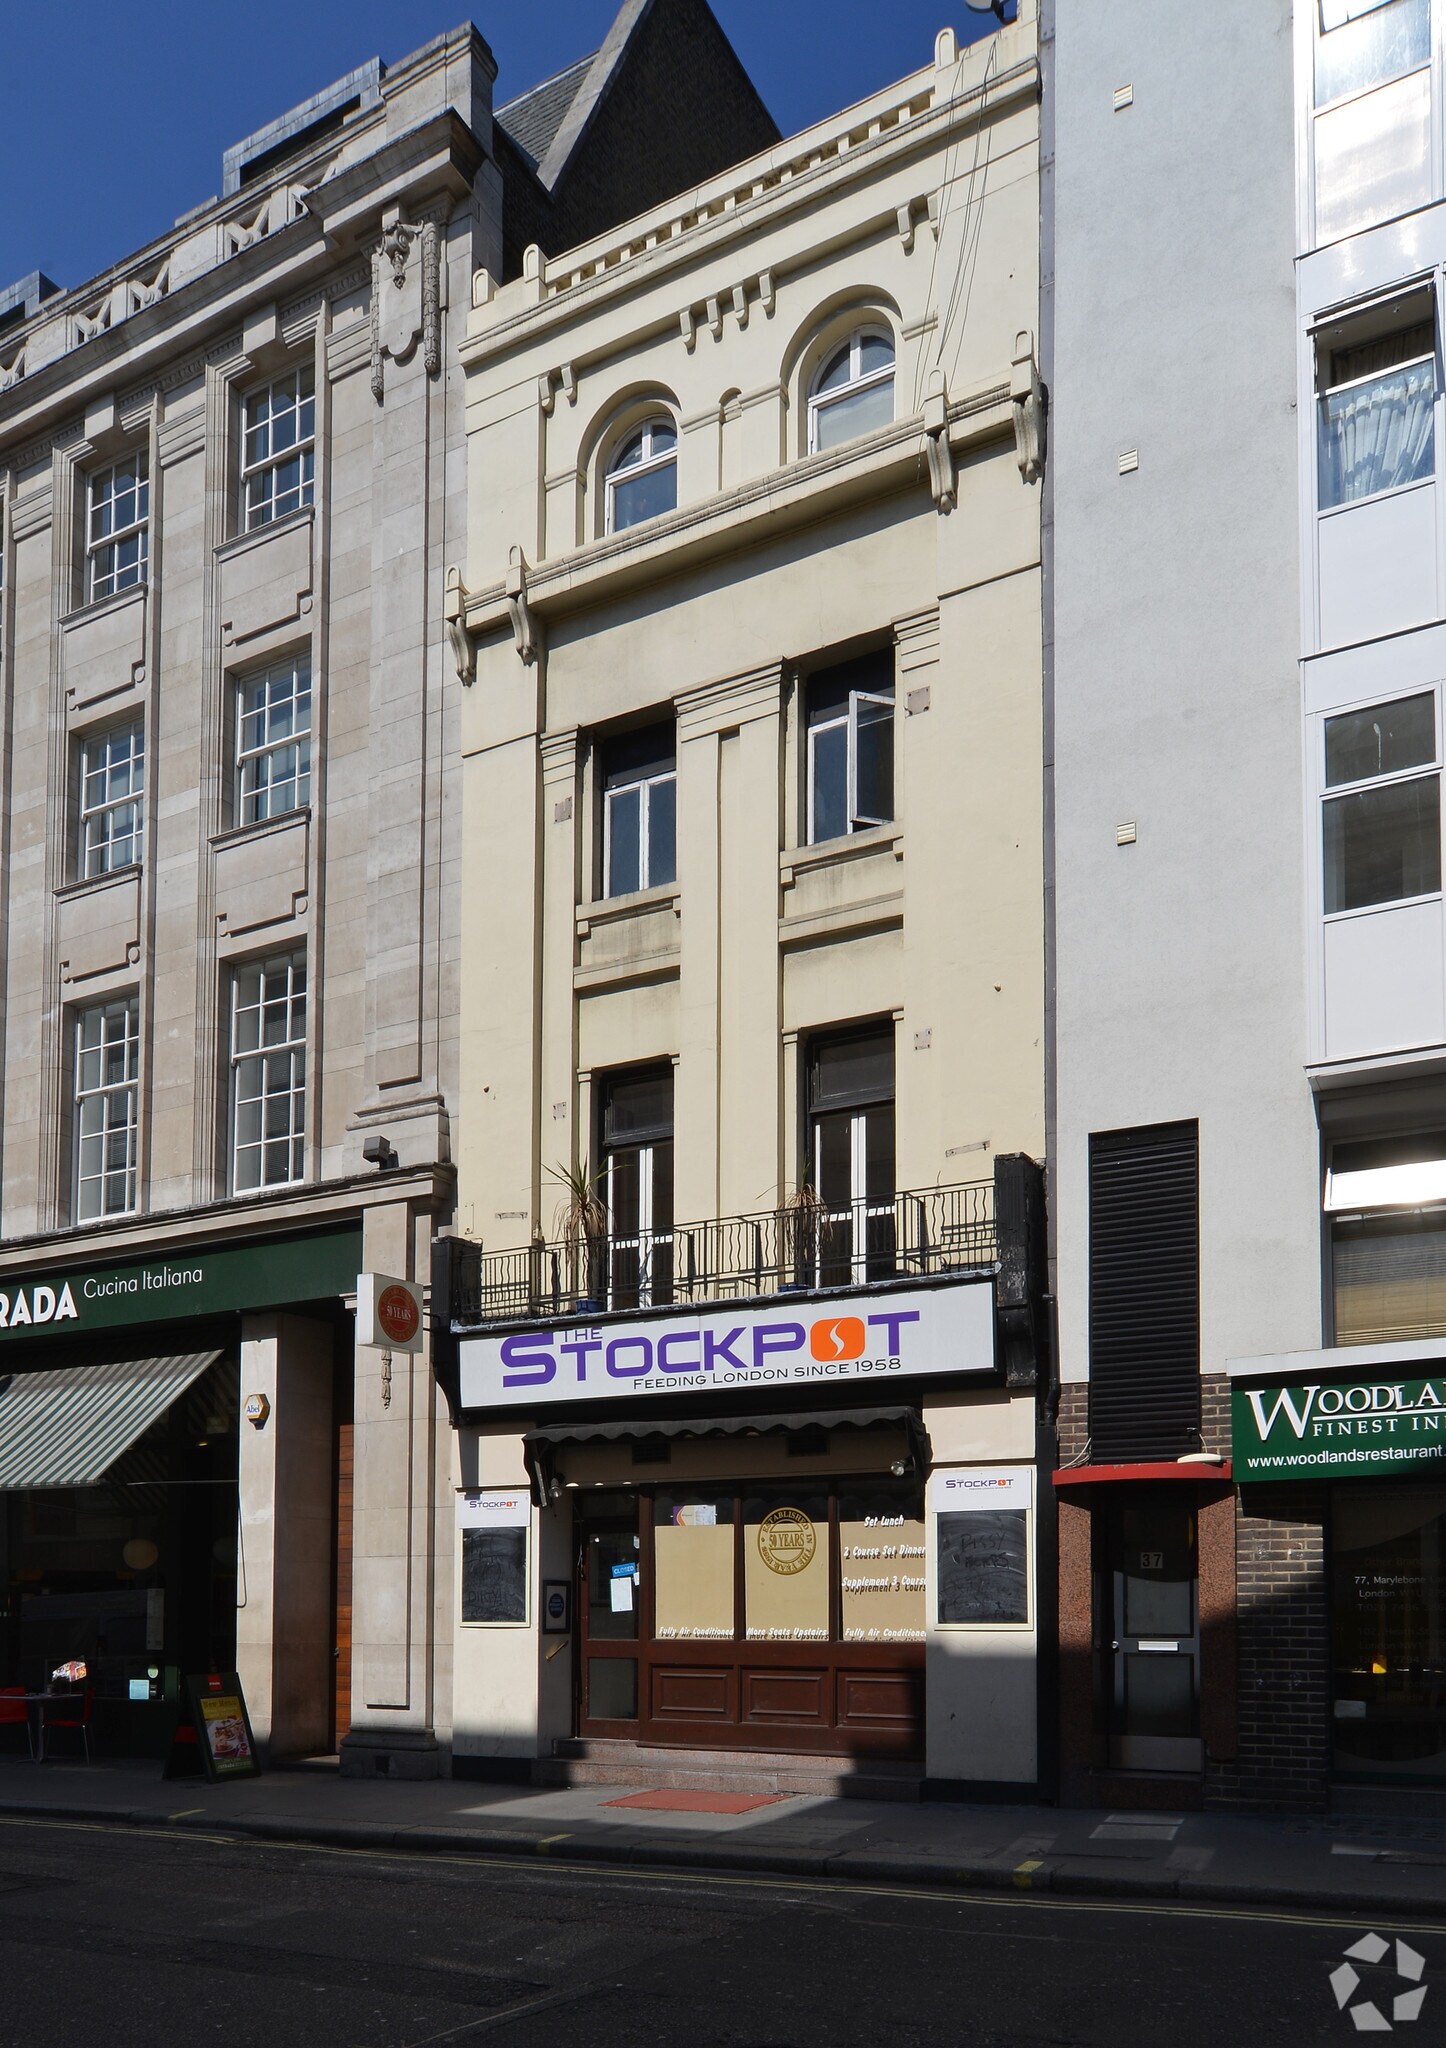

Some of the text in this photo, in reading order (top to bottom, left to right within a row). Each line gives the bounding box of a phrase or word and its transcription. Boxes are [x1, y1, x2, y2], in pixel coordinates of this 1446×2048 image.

[83, 1266, 203, 1298] Cucina Italiana
[394, 1306, 411, 1321] YEARS
[564, 1328, 603, 1343] THE
[633, 1357, 902, 1390] FEEDING LONDON SINCE 1958
[246, 1404, 260, 1413] Abel
[1245, 1382, 1446, 1441] WOODLA
[1312, 1415, 1446, 1437] FINEST IN
[763, 1511, 809, 1533] ESTABLISHED
[864, 1514, 904, 1526] Set Lunch
[769, 1533, 805, 1548] 50 YEARS
[806, 1535, 813, 1544] IN
[798, 1548, 812, 1566] THE
[844, 1546, 849, 1557] 2
[853, 1546, 880, 1556] Course
[882, 1545, 896, 1555] Set
[1142, 1553, 1161, 1567] 37
[613, 1565, 635, 1575] CLOSED
[774, 1563, 798, 1572] YEAR
[842, 1576, 889, 1588] Supplement
[891, 1575, 898, 1585] 3
[1354, 1575, 1370, 1585] 77,
[1373, 1575, 1426, 1586] Marylebone
[1358, 1589, 1395, 1598] London
[659, 1625, 734, 1638] Fully Air Conditioned
[746, 1626, 828, 1637] More Seats Upstairs
[845, 1627, 865, 1638] Fully
[868, 1627, 880, 1637] Air
